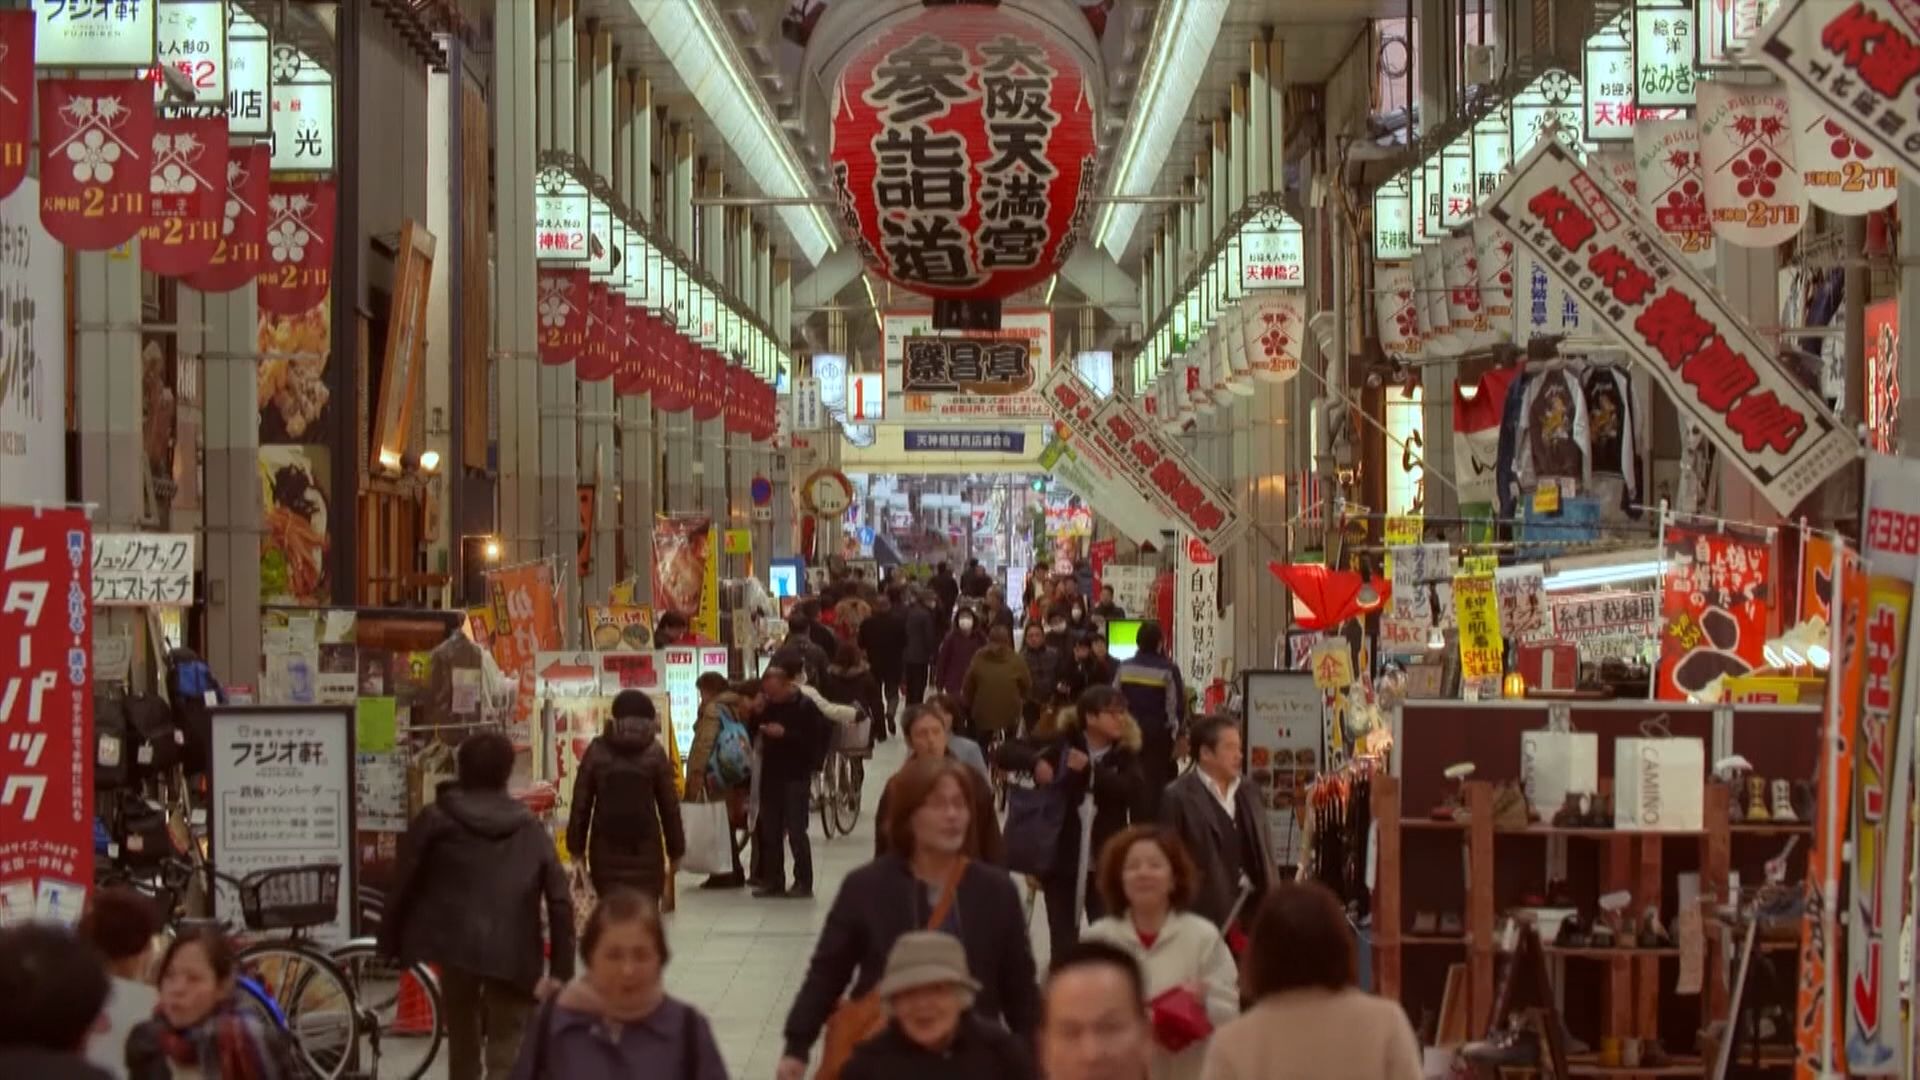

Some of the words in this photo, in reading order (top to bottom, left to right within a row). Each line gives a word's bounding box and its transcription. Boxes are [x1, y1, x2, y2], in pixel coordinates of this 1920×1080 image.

[870, 34, 979, 286] 参詣道
[981, 36, 1056, 269] 大阪天満宮
[1246, 265, 1301, 281] 天神橋2
[0, 527, 58, 822] レターパック
[230, 740, 324, 767] フジオ軒
[1642, 745, 1660, 826] CAMINO
